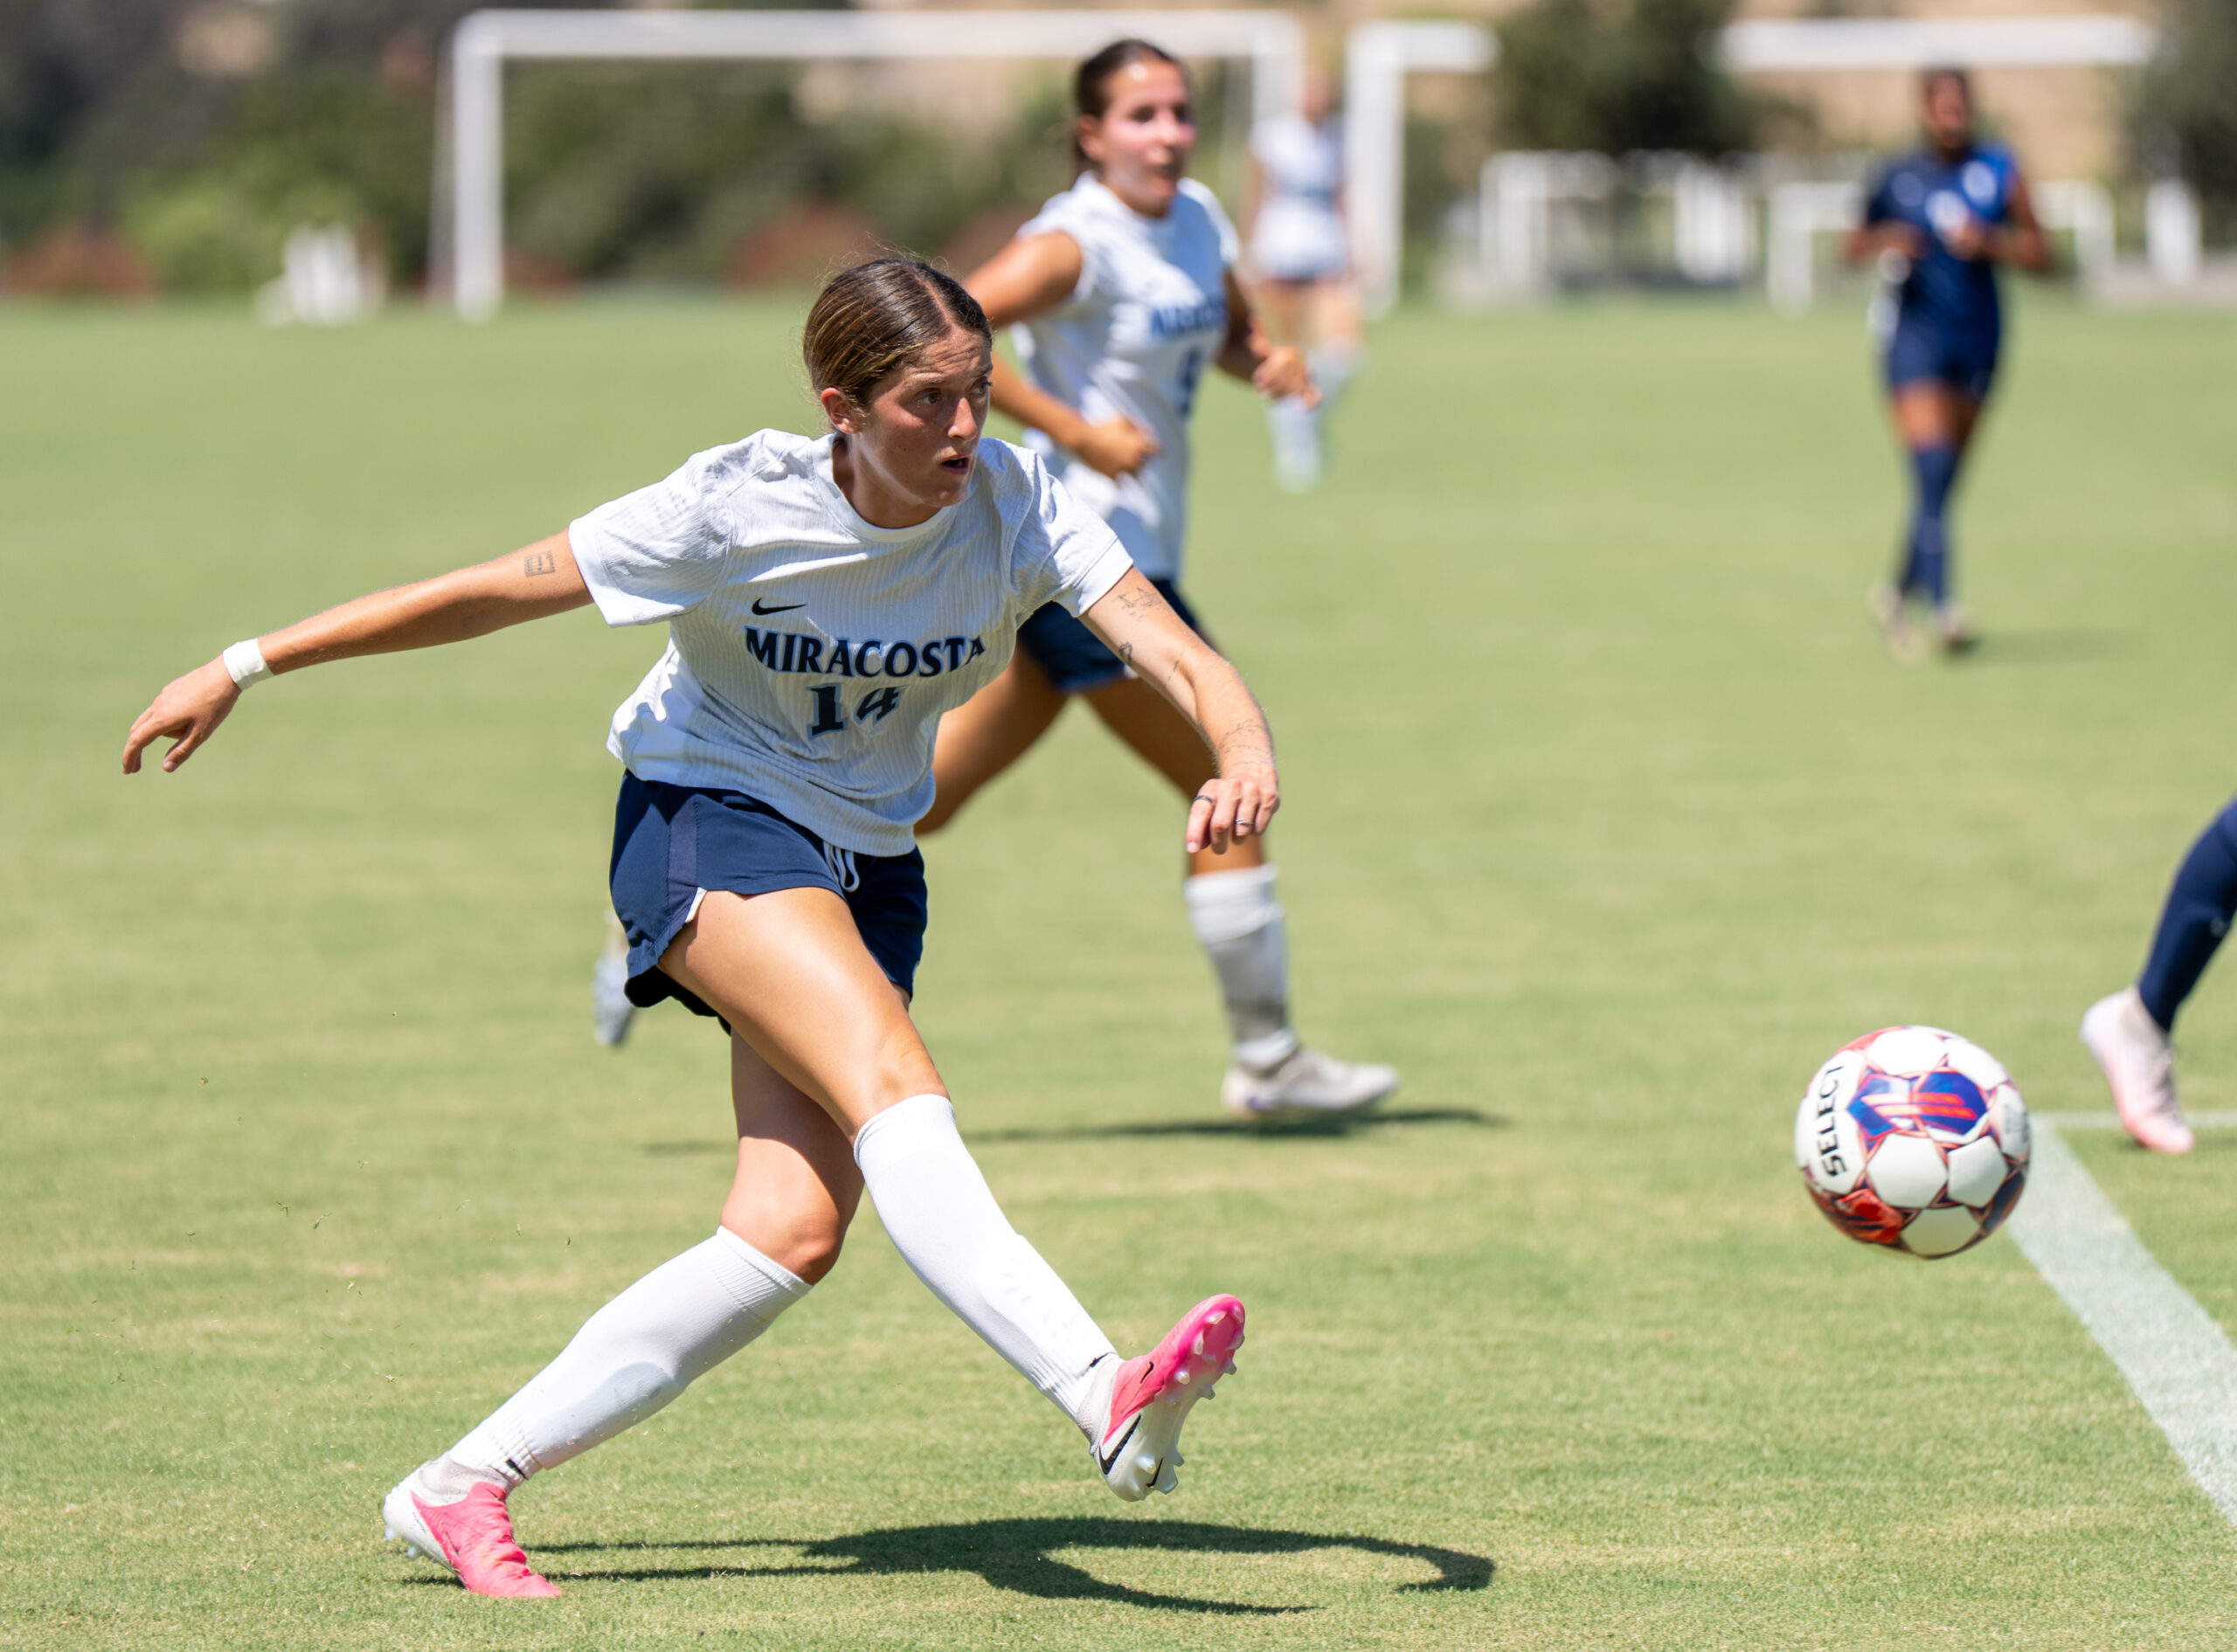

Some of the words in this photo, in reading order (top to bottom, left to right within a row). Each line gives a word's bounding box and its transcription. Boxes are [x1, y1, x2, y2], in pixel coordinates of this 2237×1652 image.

[744, 625, 987, 679] MIRACOSTA
[806, 682, 907, 740] 14
[1818, 1064, 1848, 1177] SELECT
